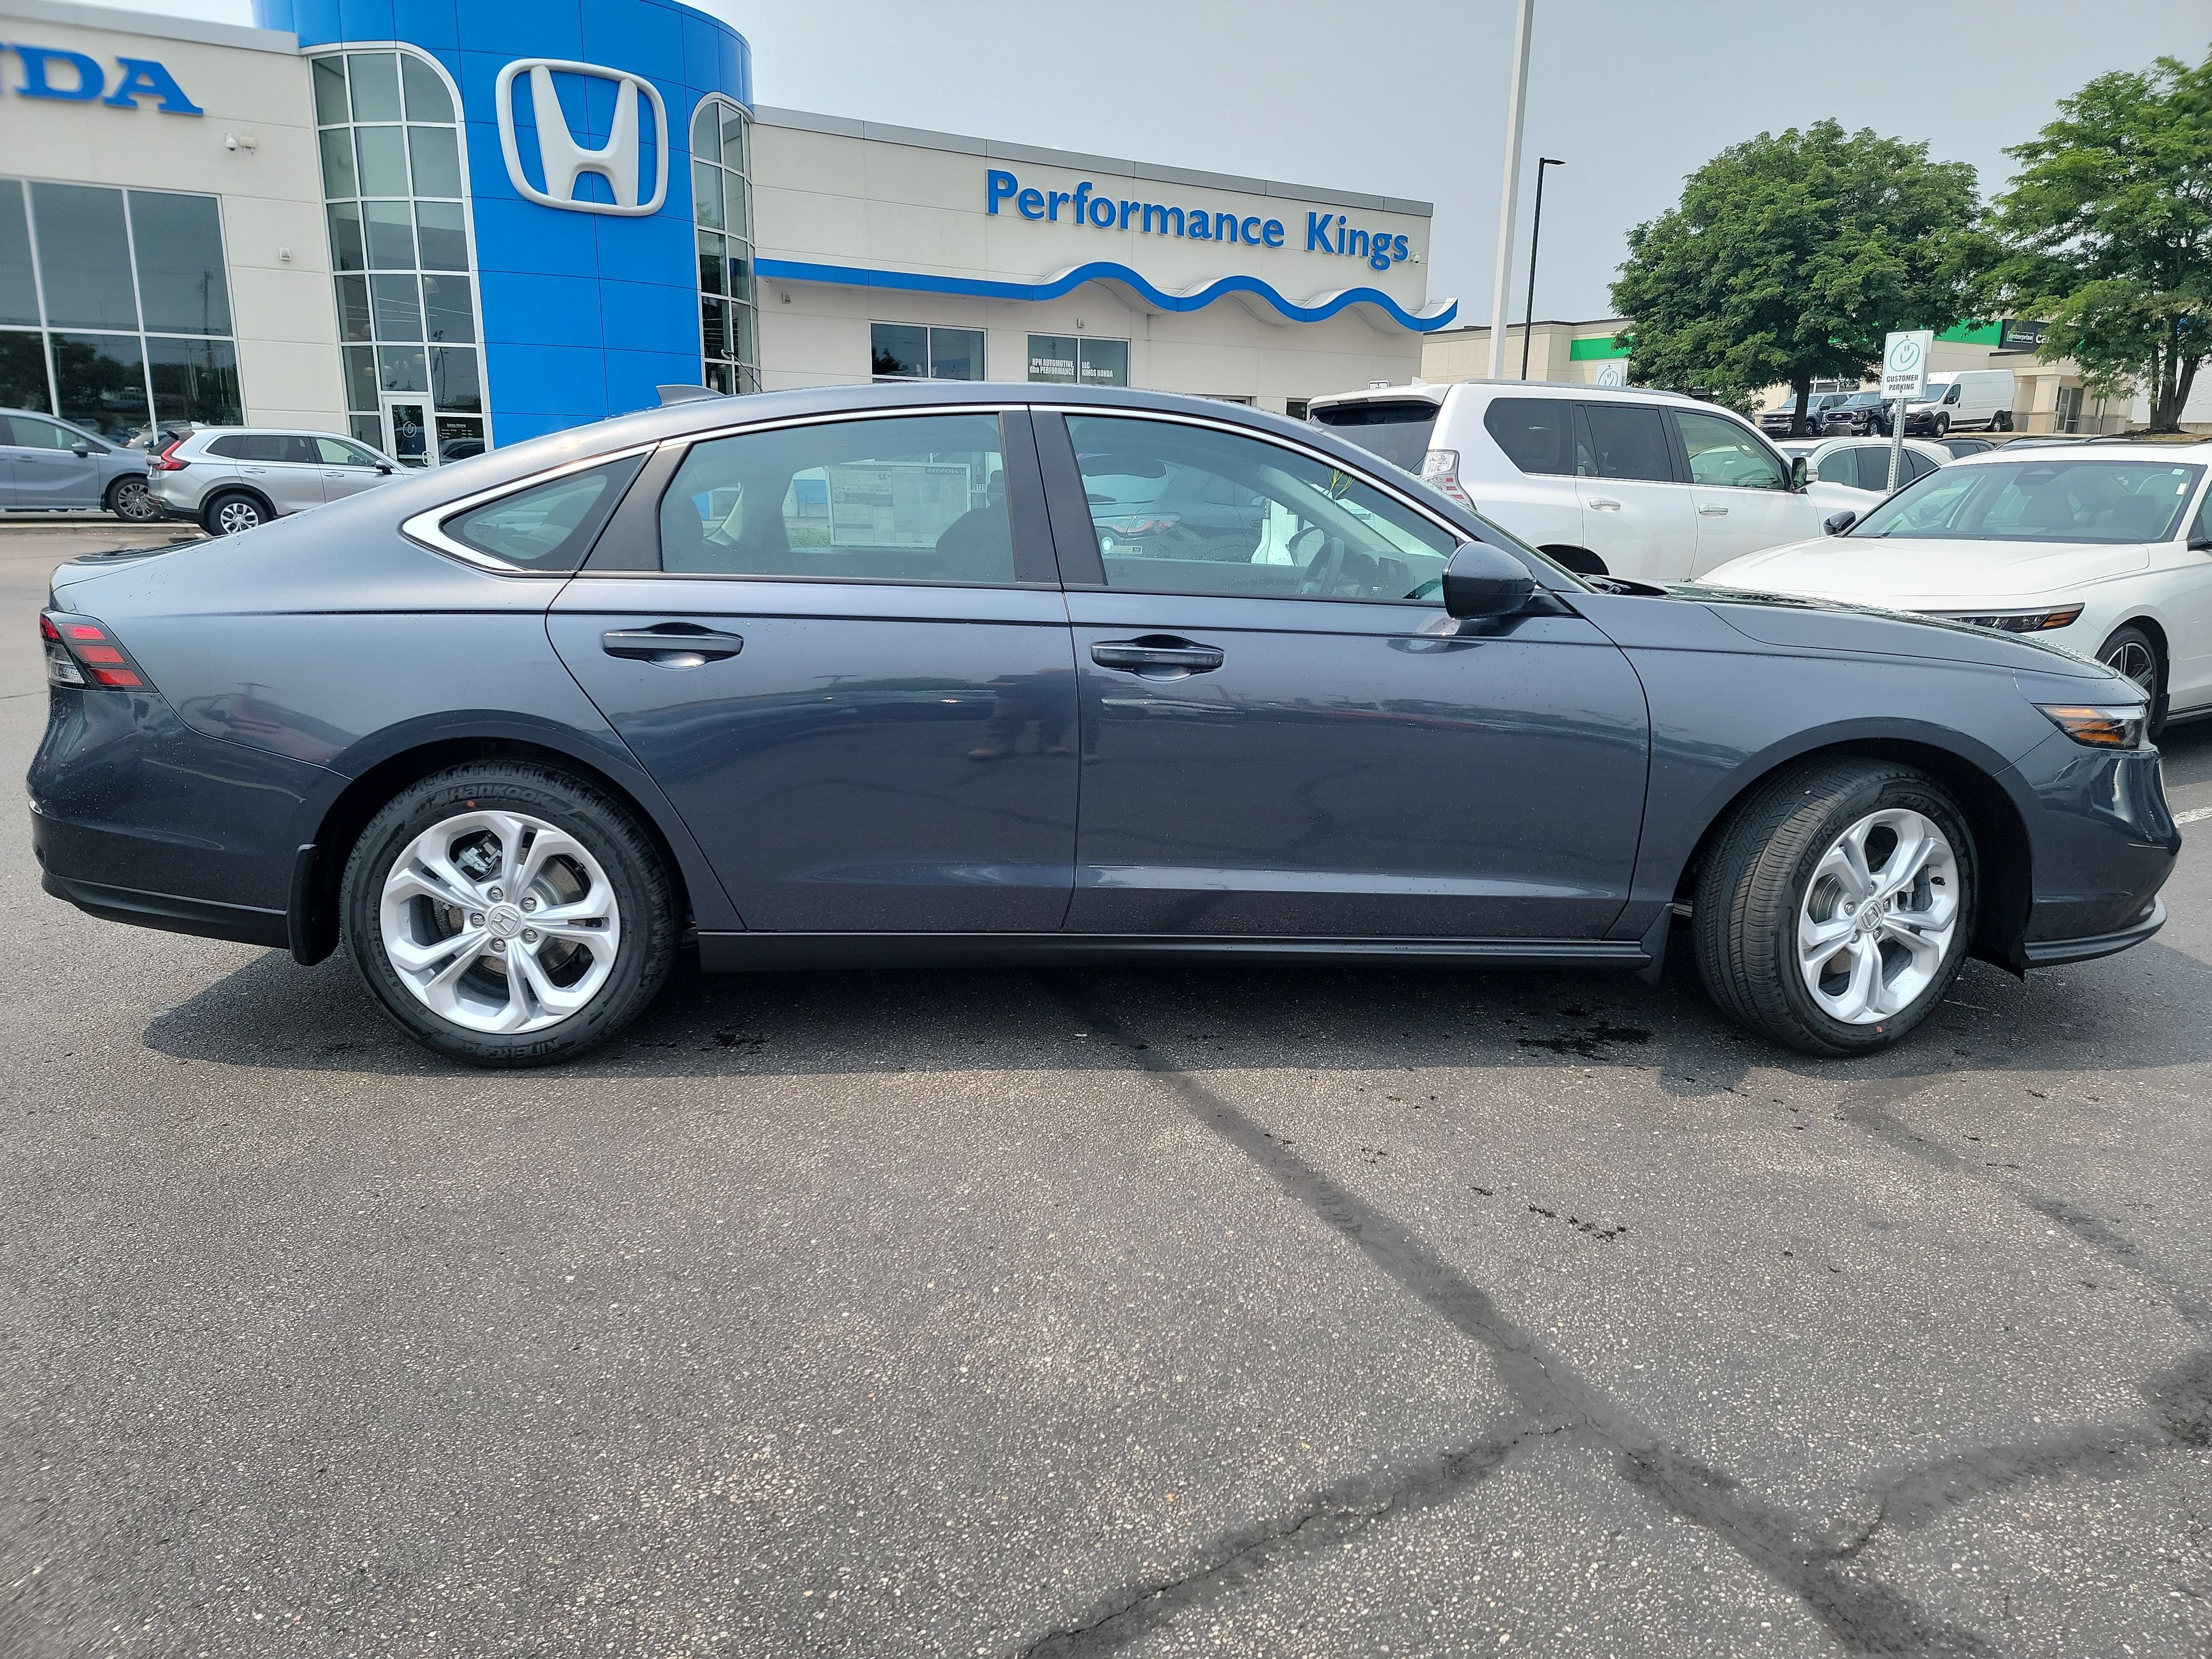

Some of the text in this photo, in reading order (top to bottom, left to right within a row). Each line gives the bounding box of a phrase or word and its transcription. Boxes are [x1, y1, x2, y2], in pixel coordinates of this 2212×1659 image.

[0, 42, 204, 115] DA
[986, 169, 1409, 271] Performance Kings
[1032, 358, 1042, 366] KPH
[1040, 366, 1074, 375] PERFORMANCE
[1082, 369, 1097, 377] KINGS
[1097, 369, 1113, 378] HONDA
[1886, 374, 1918, 383] CUSTOMER
